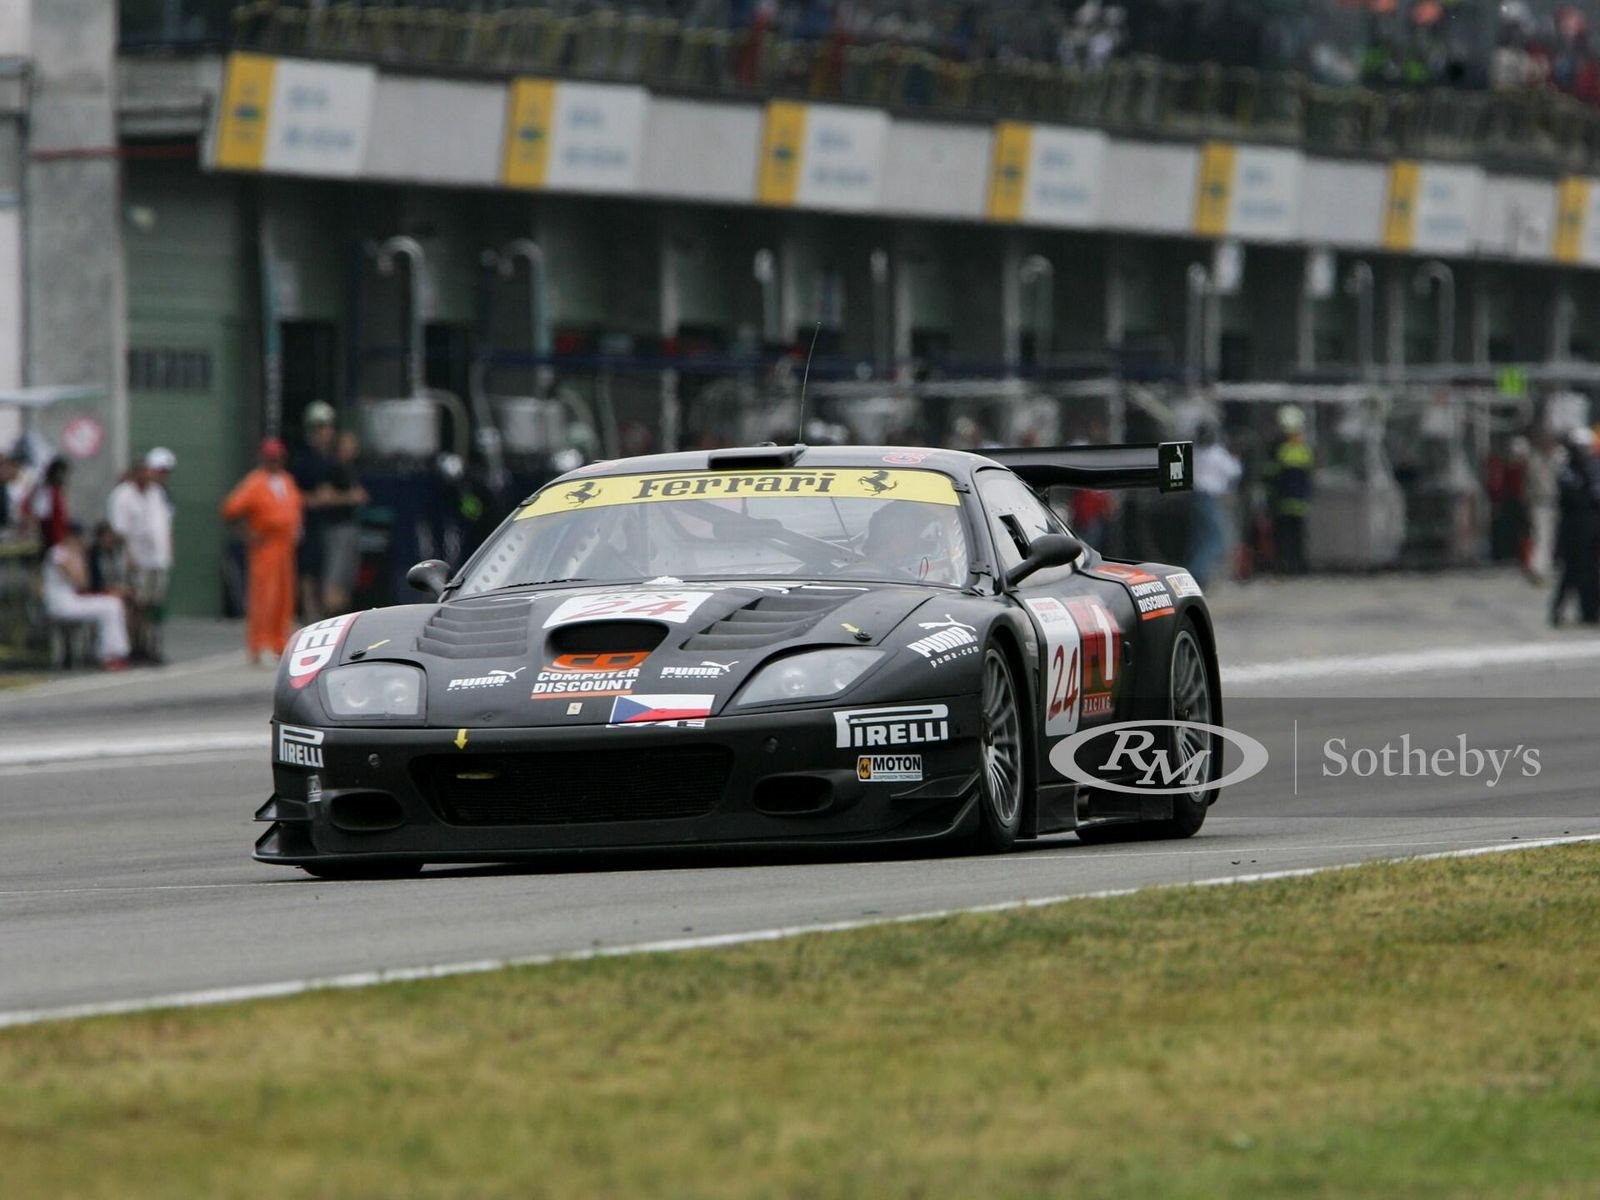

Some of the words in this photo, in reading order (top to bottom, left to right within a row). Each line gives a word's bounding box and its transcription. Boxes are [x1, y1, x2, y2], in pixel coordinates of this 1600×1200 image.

[632, 472, 836, 499] Ferrari
[1131, 582, 1168, 597] COMPUTER
[560, 600, 689, 622] 24
[1138, 594, 1173, 613] DISCOUNT
[906, 626, 974, 658] PUMA
[537, 667, 640, 681] COMPUTER
[661, 667, 721, 676] PUMA
[448, 675, 508, 688] PUMA
[532, 679, 637, 694] DISCOUNT
[1048, 644, 1079, 722] 24
[1083, 696, 1111, 713] RACING
[833, 704, 949, 748] PIRELLI
[279, 724, 325, 769] PIRELLI
[873, 756, 921, 771] MOTON
